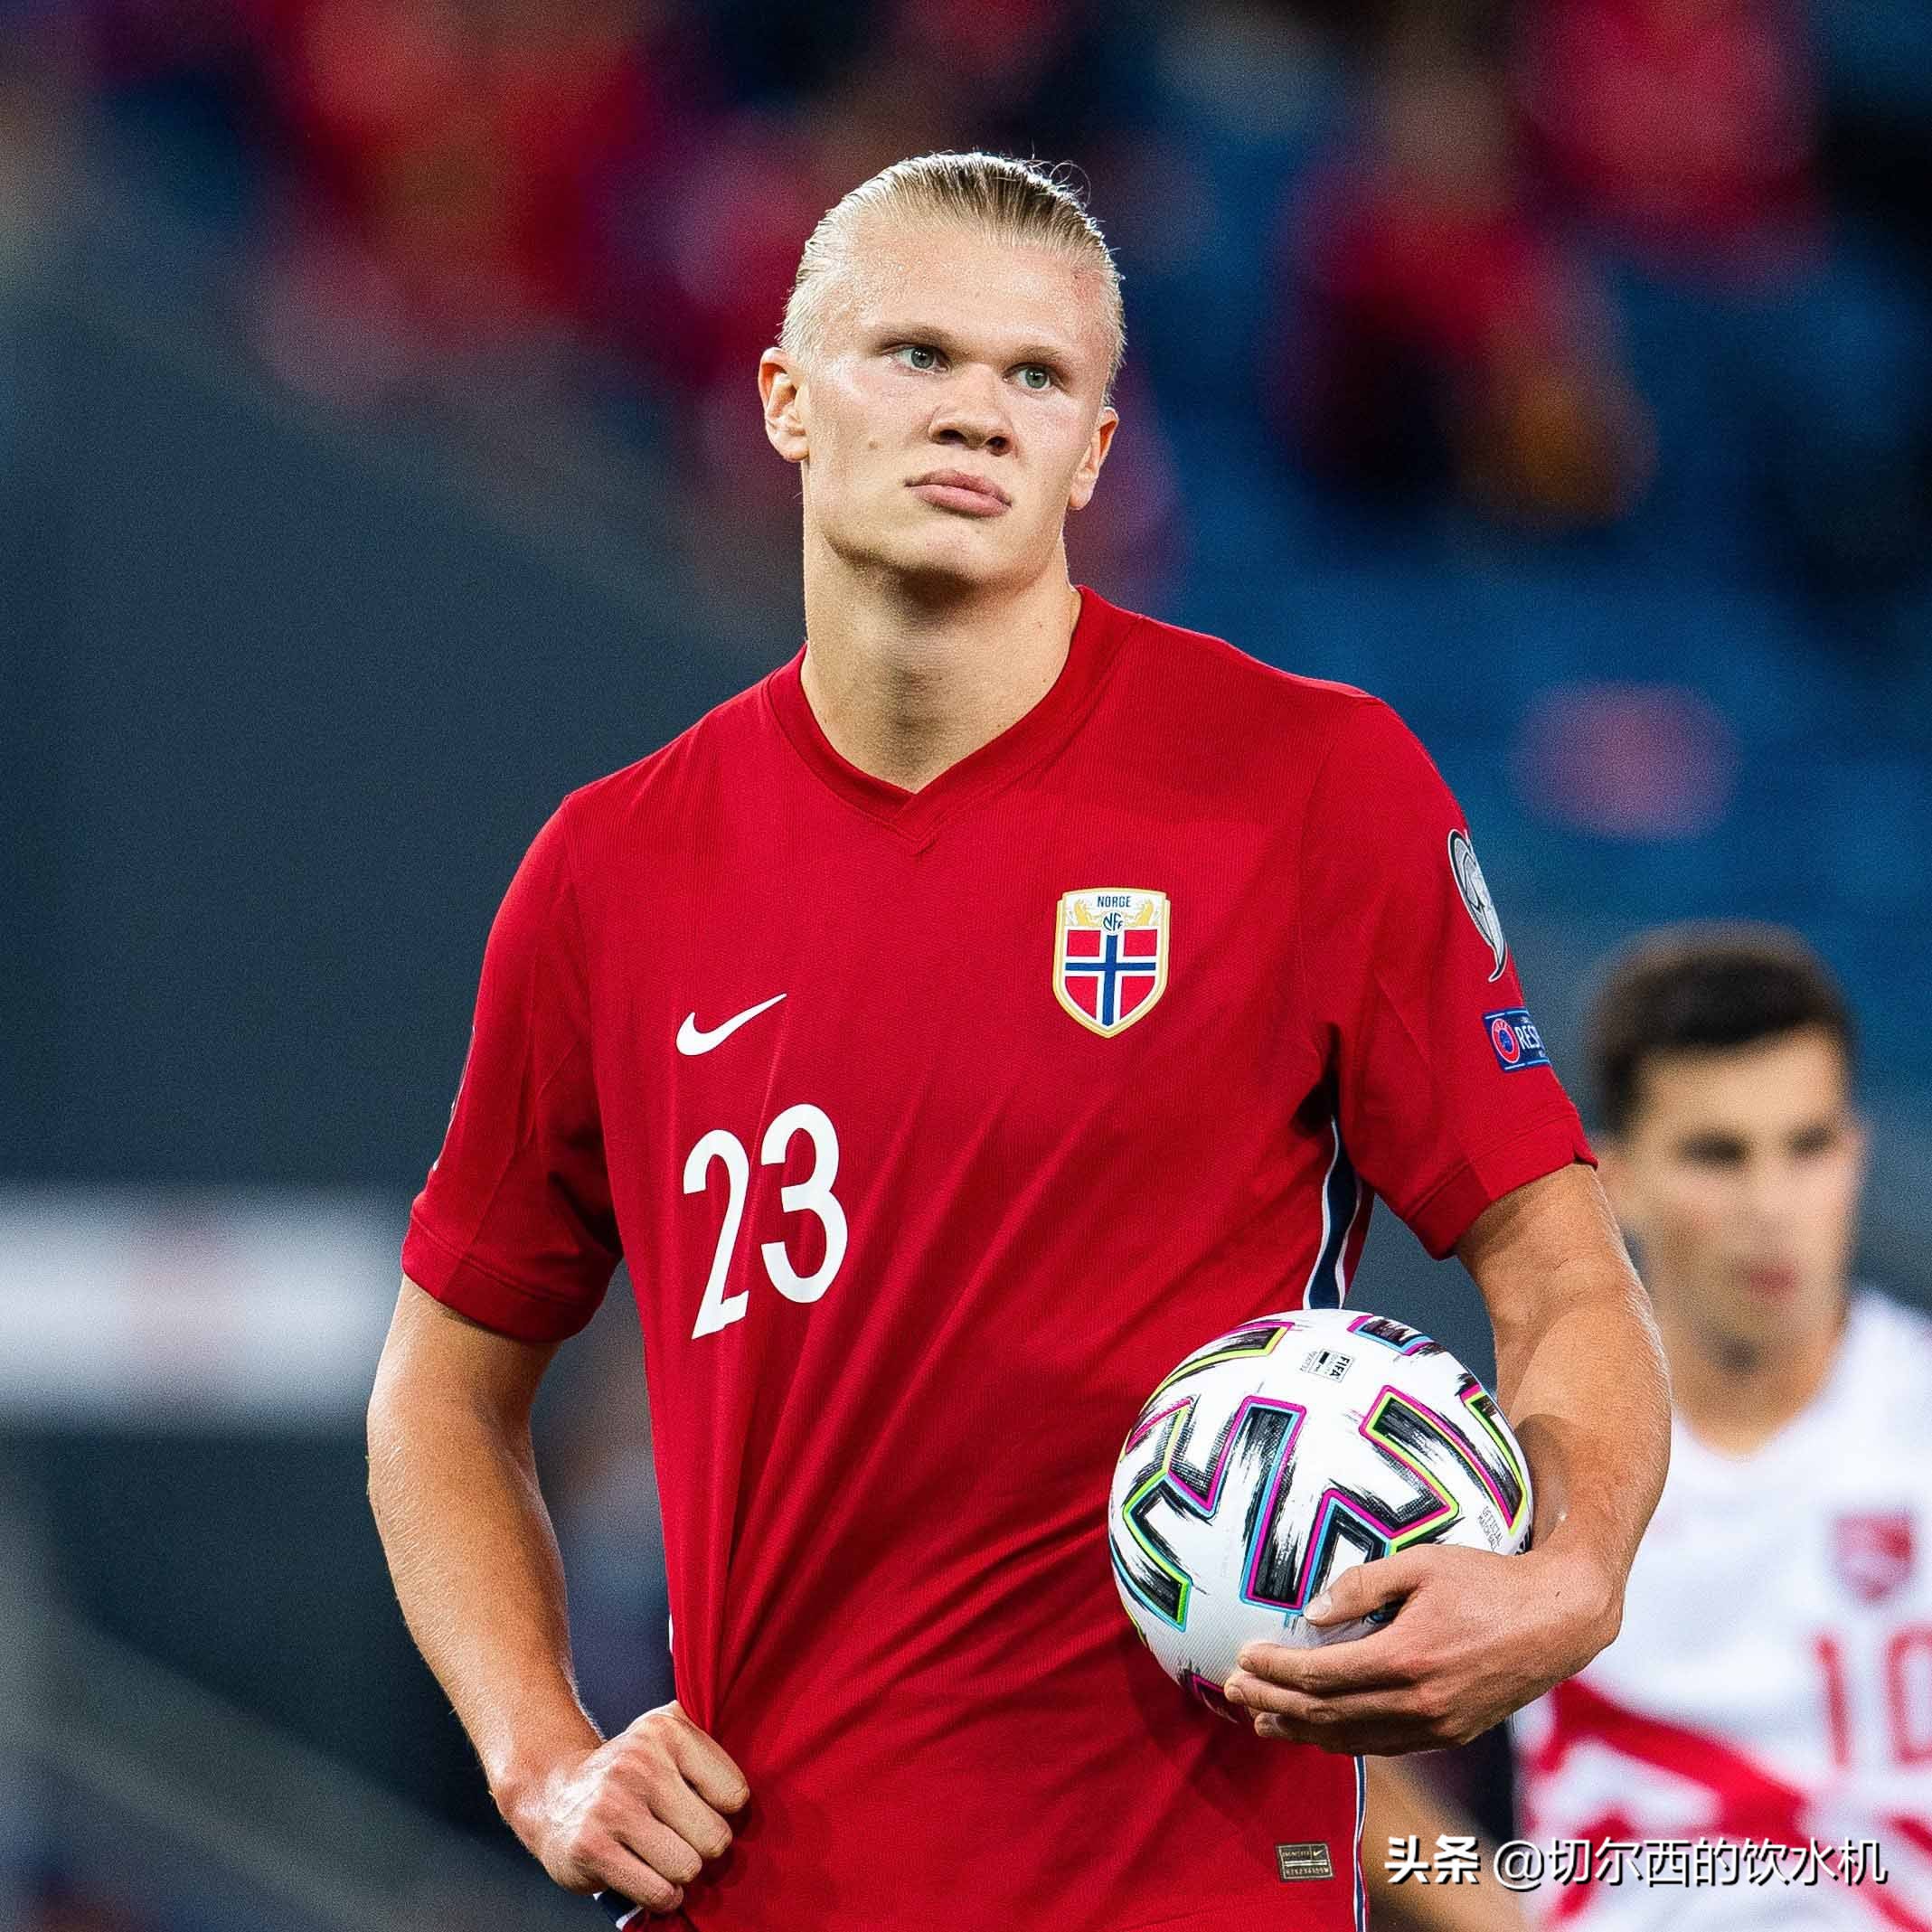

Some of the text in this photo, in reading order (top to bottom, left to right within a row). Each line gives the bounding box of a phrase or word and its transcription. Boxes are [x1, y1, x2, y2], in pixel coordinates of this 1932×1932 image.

[1097, 895, 1132, 908] NORGE
[1513, 1024, 1546, 1051] RES
[683, 1103, 848, 1340] 23
[1329, 1355, 1350, 1377] FIFA
